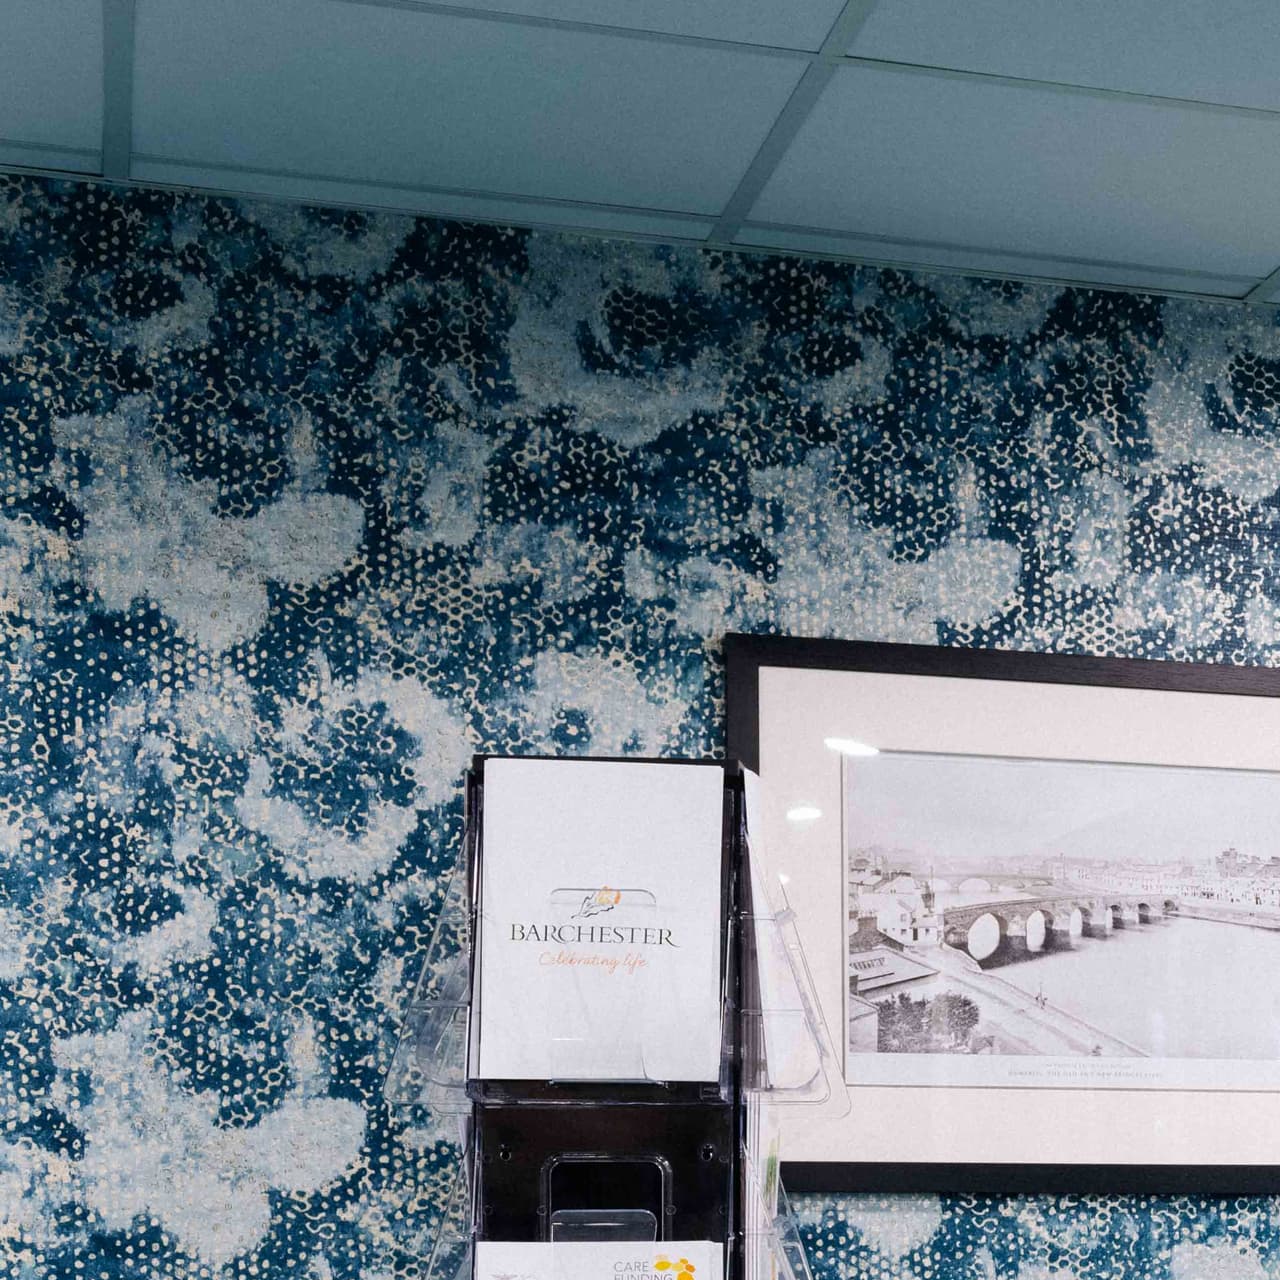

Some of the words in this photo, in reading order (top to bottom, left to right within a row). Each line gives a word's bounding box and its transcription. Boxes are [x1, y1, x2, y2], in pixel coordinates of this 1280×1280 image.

[510, 923, 681, 948] BARCHESTER
[538, 950, 619, 975] Celebrating
[622, 951, 648, 975] life
[614, 1260, 649, 1273] CARE
